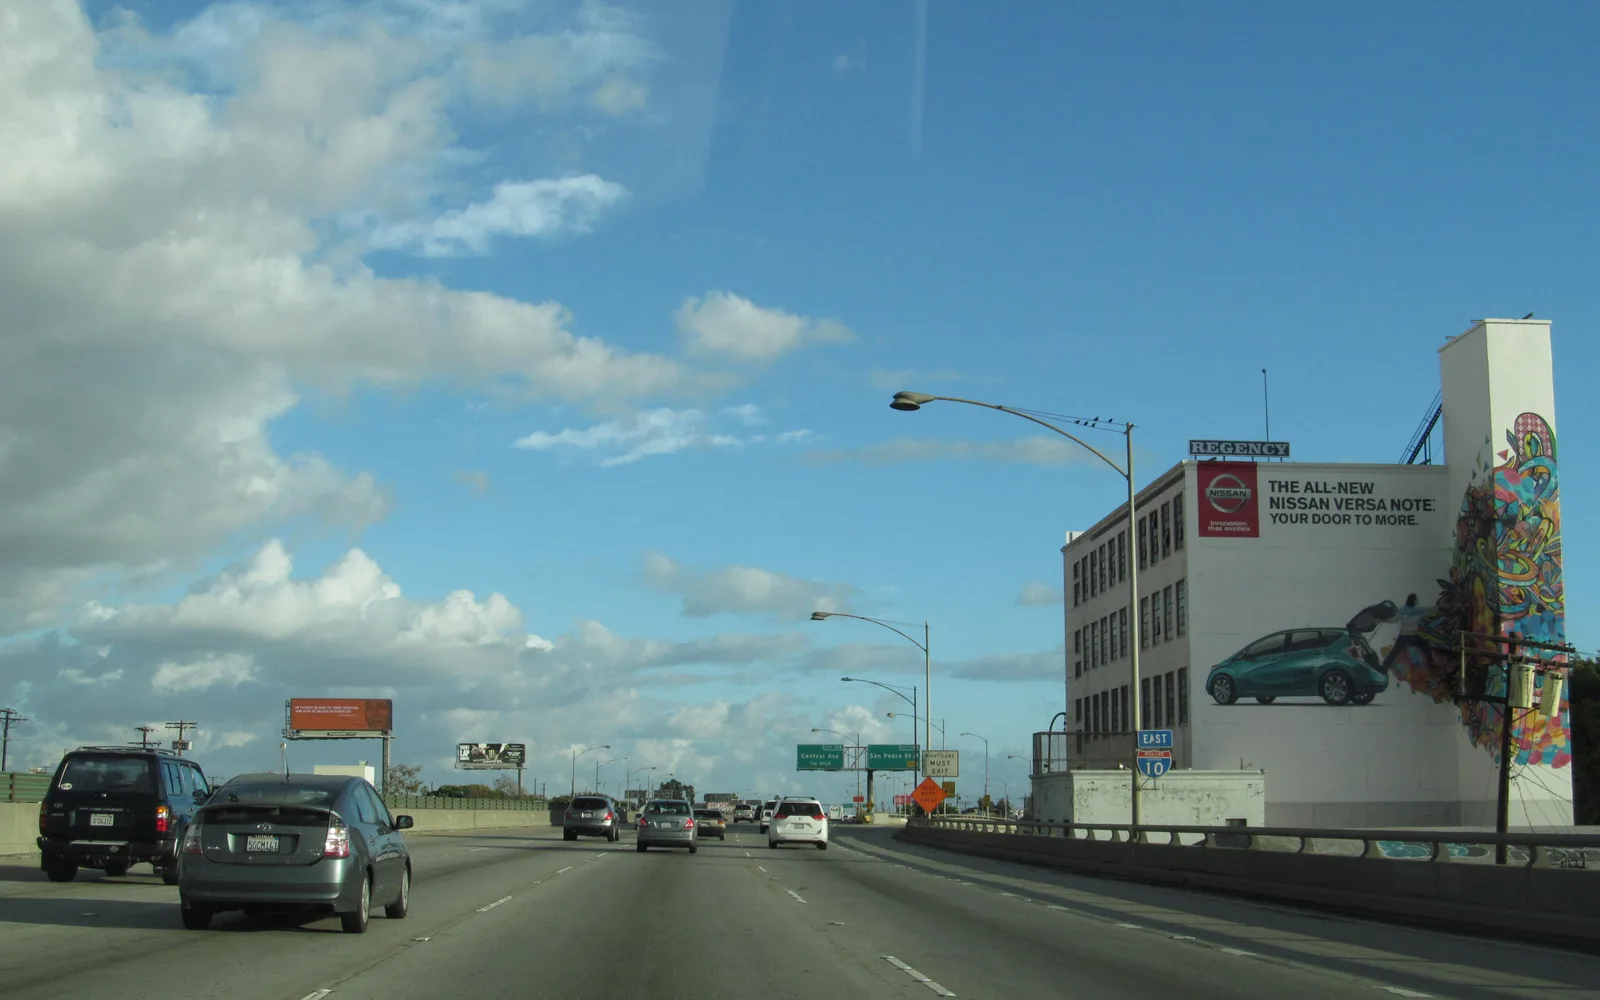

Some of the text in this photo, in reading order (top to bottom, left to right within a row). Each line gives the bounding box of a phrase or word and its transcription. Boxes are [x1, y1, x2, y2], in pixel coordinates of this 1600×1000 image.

[1191, 441, 1288, 455] REGENCY
[1268, 480, 1375, 495] THE ALL-NEW
[1269, 497, 1330, 511] NISSAN
[1333, 497, 1388, 511] VERSA
[1270, 513, 1419, 526] YOUR DOOR TO MORE.
[1143, 734, 1167, 744] EAST
[1146, 761, 1164, 775] 10
